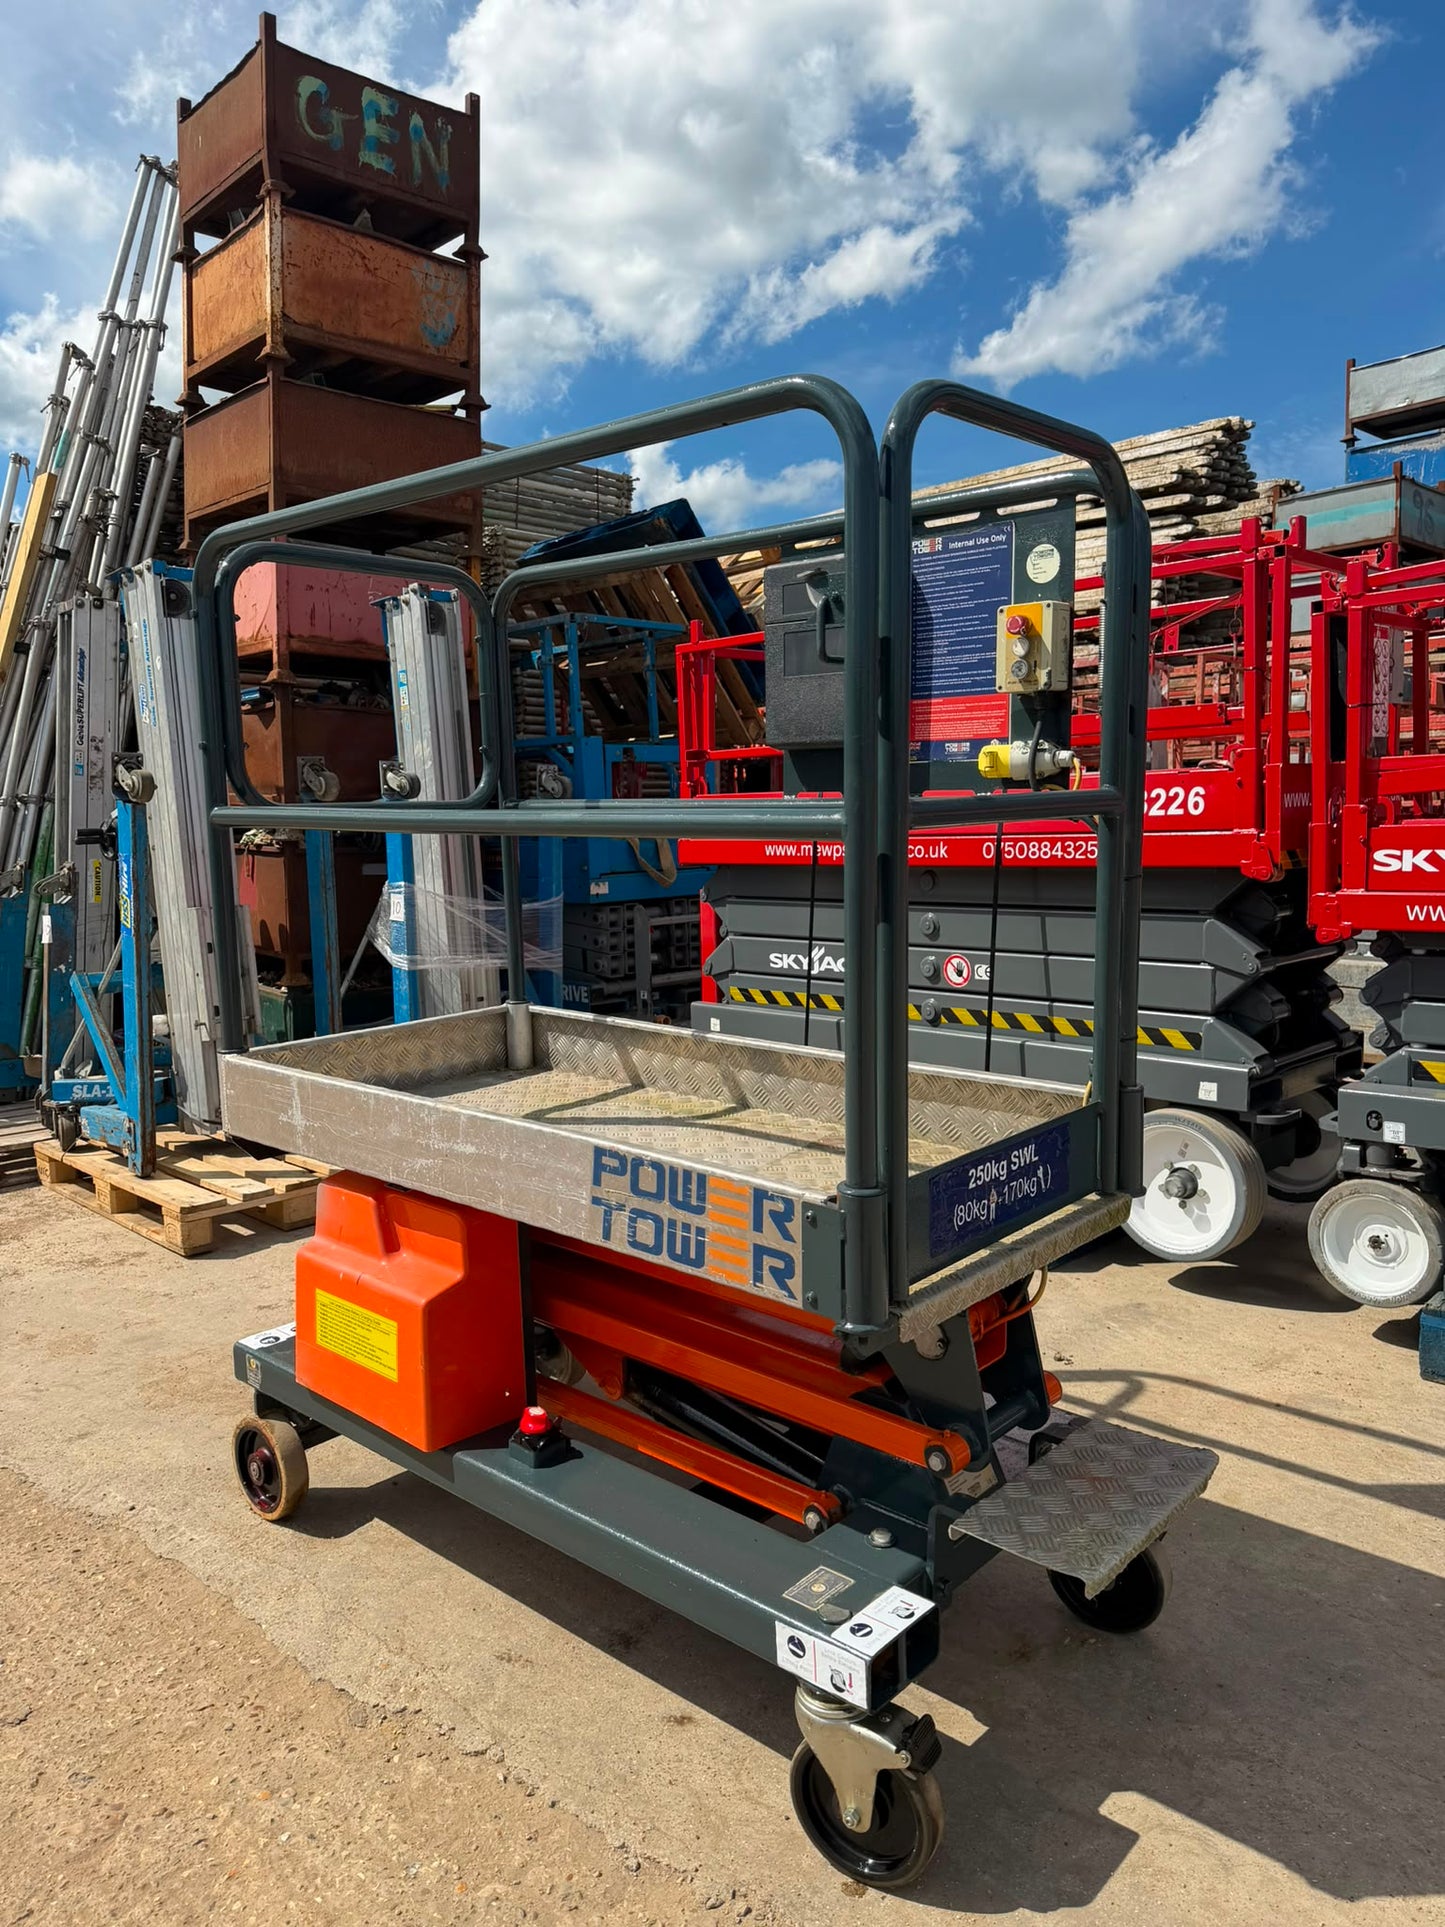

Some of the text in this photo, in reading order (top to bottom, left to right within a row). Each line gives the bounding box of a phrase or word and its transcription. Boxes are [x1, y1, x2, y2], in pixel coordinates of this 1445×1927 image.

[295, 74, 453, 194] GEN
[912, 533, 1007, 550] POWER Internal Use Only
[912, 544, 943, 555] TOWER
[76, 683, 85, 724] SUPERLIFT
[1144, 785, 1206, 816] 226
[968, 1144, 1039, 1190] 250kg SWL
[592, 1145, 797, 1244] POWER
[591, 1195, 798, 1301] TOWER
